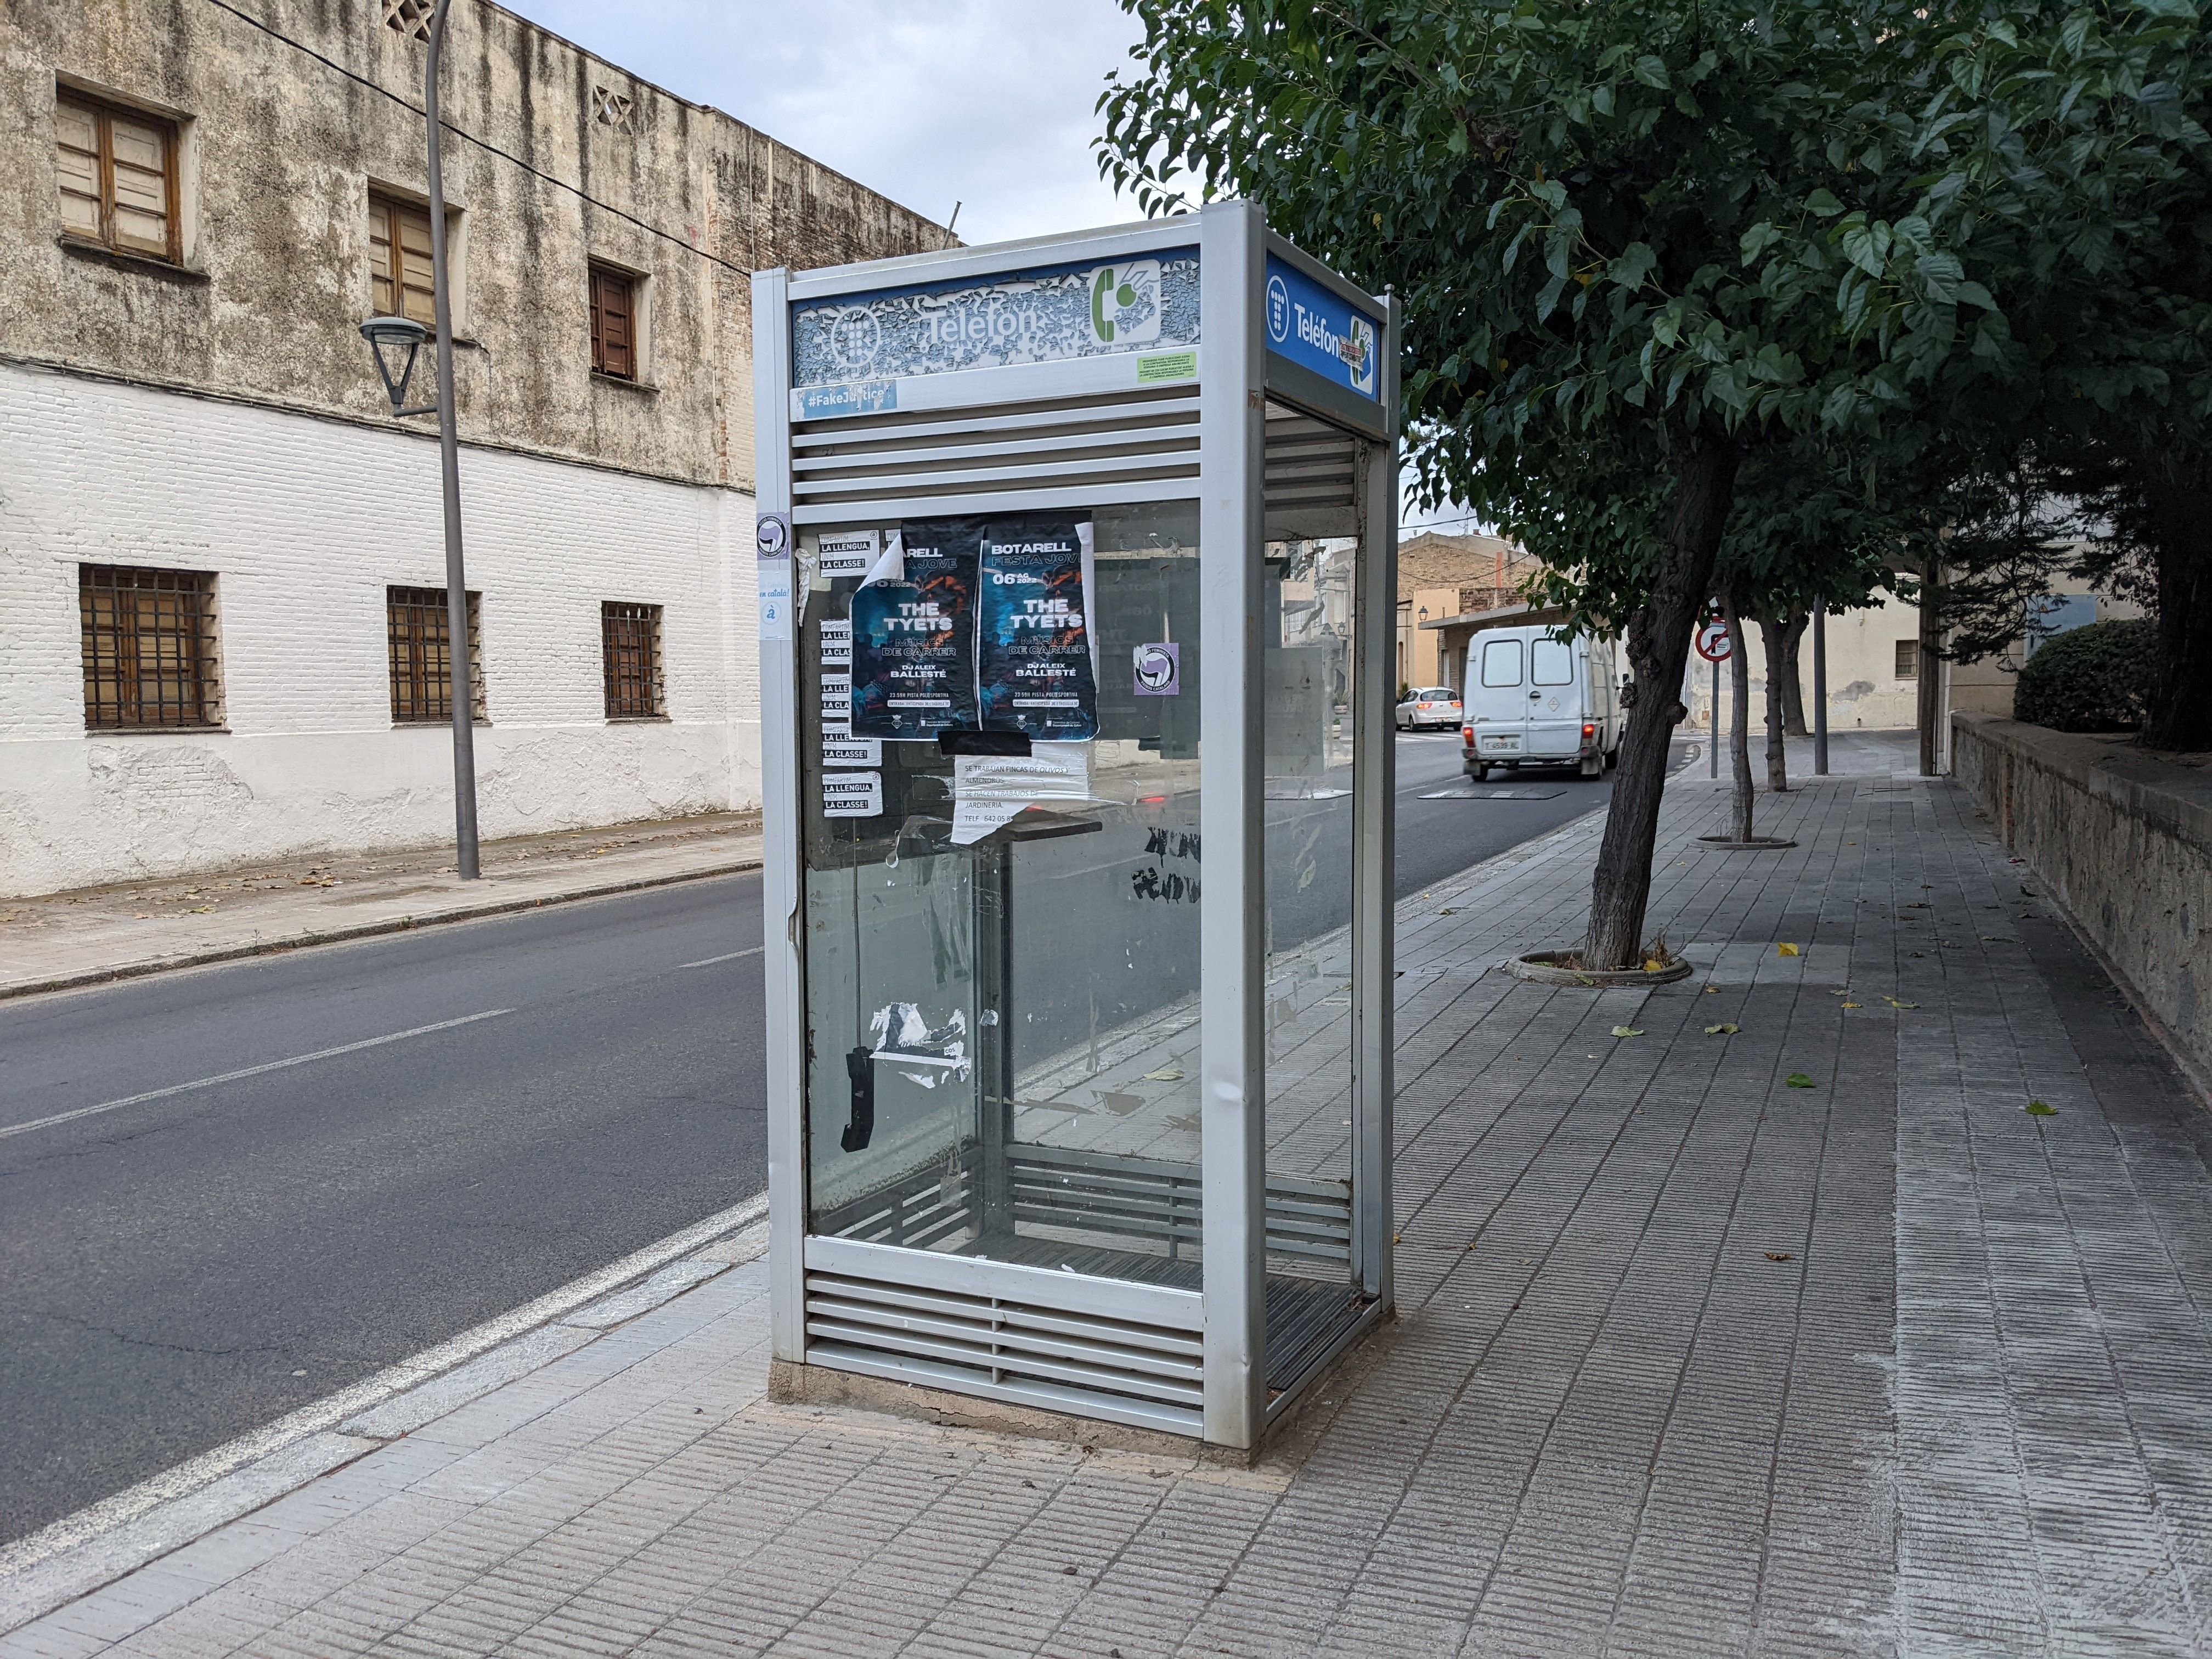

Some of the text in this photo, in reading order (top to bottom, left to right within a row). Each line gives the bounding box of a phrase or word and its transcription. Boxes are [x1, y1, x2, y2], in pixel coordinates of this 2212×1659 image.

[1295, 303, 1339, 358] Teléfon
[808, 388, 884, 407] #FakeJutice
[833, 542, 870, 551] LLENGUA,
[991, 542, 1072, 555] BOTARELL
[833, 560, 864, 568] CLASSE!
[918, 558, 957, 569] JOVE
[991, 555, 1043, 566] FESTA
[992, 573, 1015, 585] 06
[898, 602, 939, 616] THE
[1023, 599, 1068, 613] THE
[883, 618, 952, 631] TYETS
[1010, 614, 1083, 629] TYETS
[882, 648, 957, 656] DE CARRER
[1008, 645, 1086, 655] DE CARRER
[1152, 649, 1169, 658] FEMINISTA
[890, 669, 947, 678] BALLESTÉ
[1016, 667, 1076, 676] BALLESTÉ
[1153, 681, 1170, 691] CATALANS
